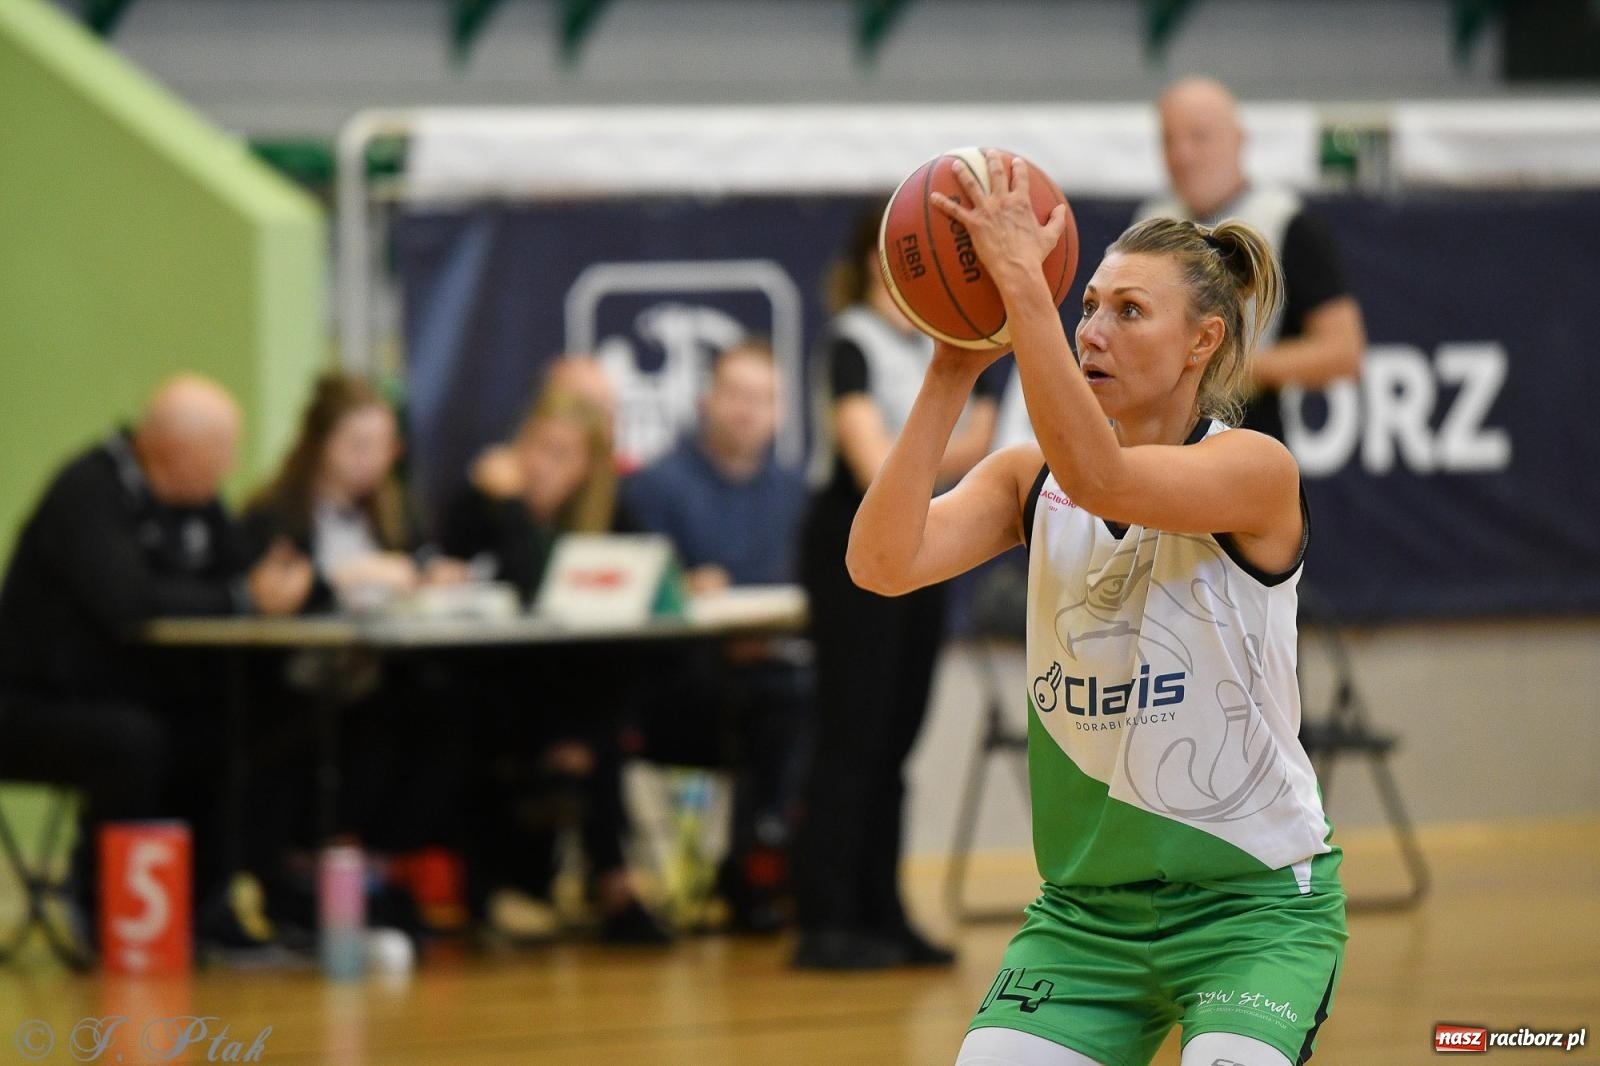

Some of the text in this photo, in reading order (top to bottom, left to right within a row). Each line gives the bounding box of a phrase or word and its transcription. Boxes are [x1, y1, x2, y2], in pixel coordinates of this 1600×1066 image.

[902, 233, 926, 279] FIBA
[1075, 712, 1176, 732] DORABI KLUCZY
[978, 967, 1054, 1014] 14
